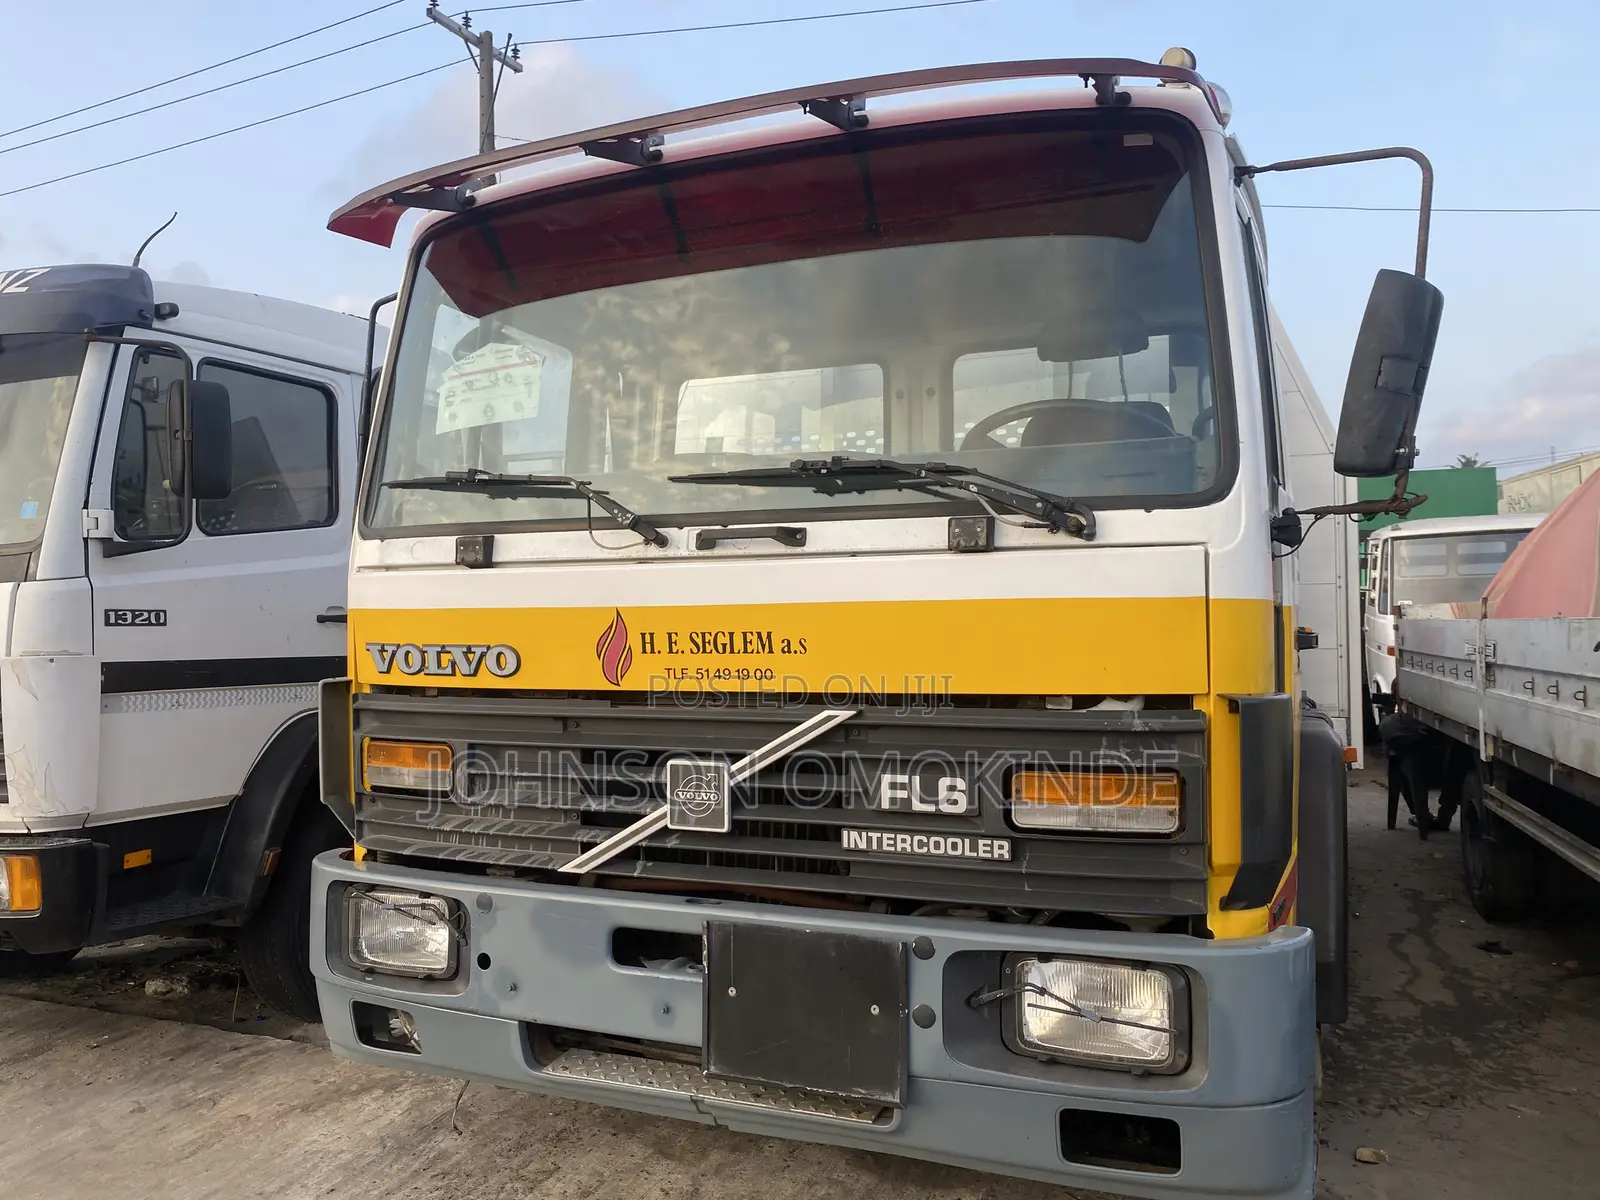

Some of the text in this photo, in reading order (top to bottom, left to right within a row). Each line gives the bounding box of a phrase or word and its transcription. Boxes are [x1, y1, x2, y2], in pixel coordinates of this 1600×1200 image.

[108, 611, 165, 624] 1320
[640, 631, 807, 655] H. E. SEGLEM a.s
[366, 642, 521, 678] VOLVO
[664, 668, 692, 680] TLF.
[754, 668, 774, 680] 00
[677, 791, 719, 801] VOLVO
[880, 773, 968, 815] FL6
[842, 830, 1010, 860] INTERCOOLER
